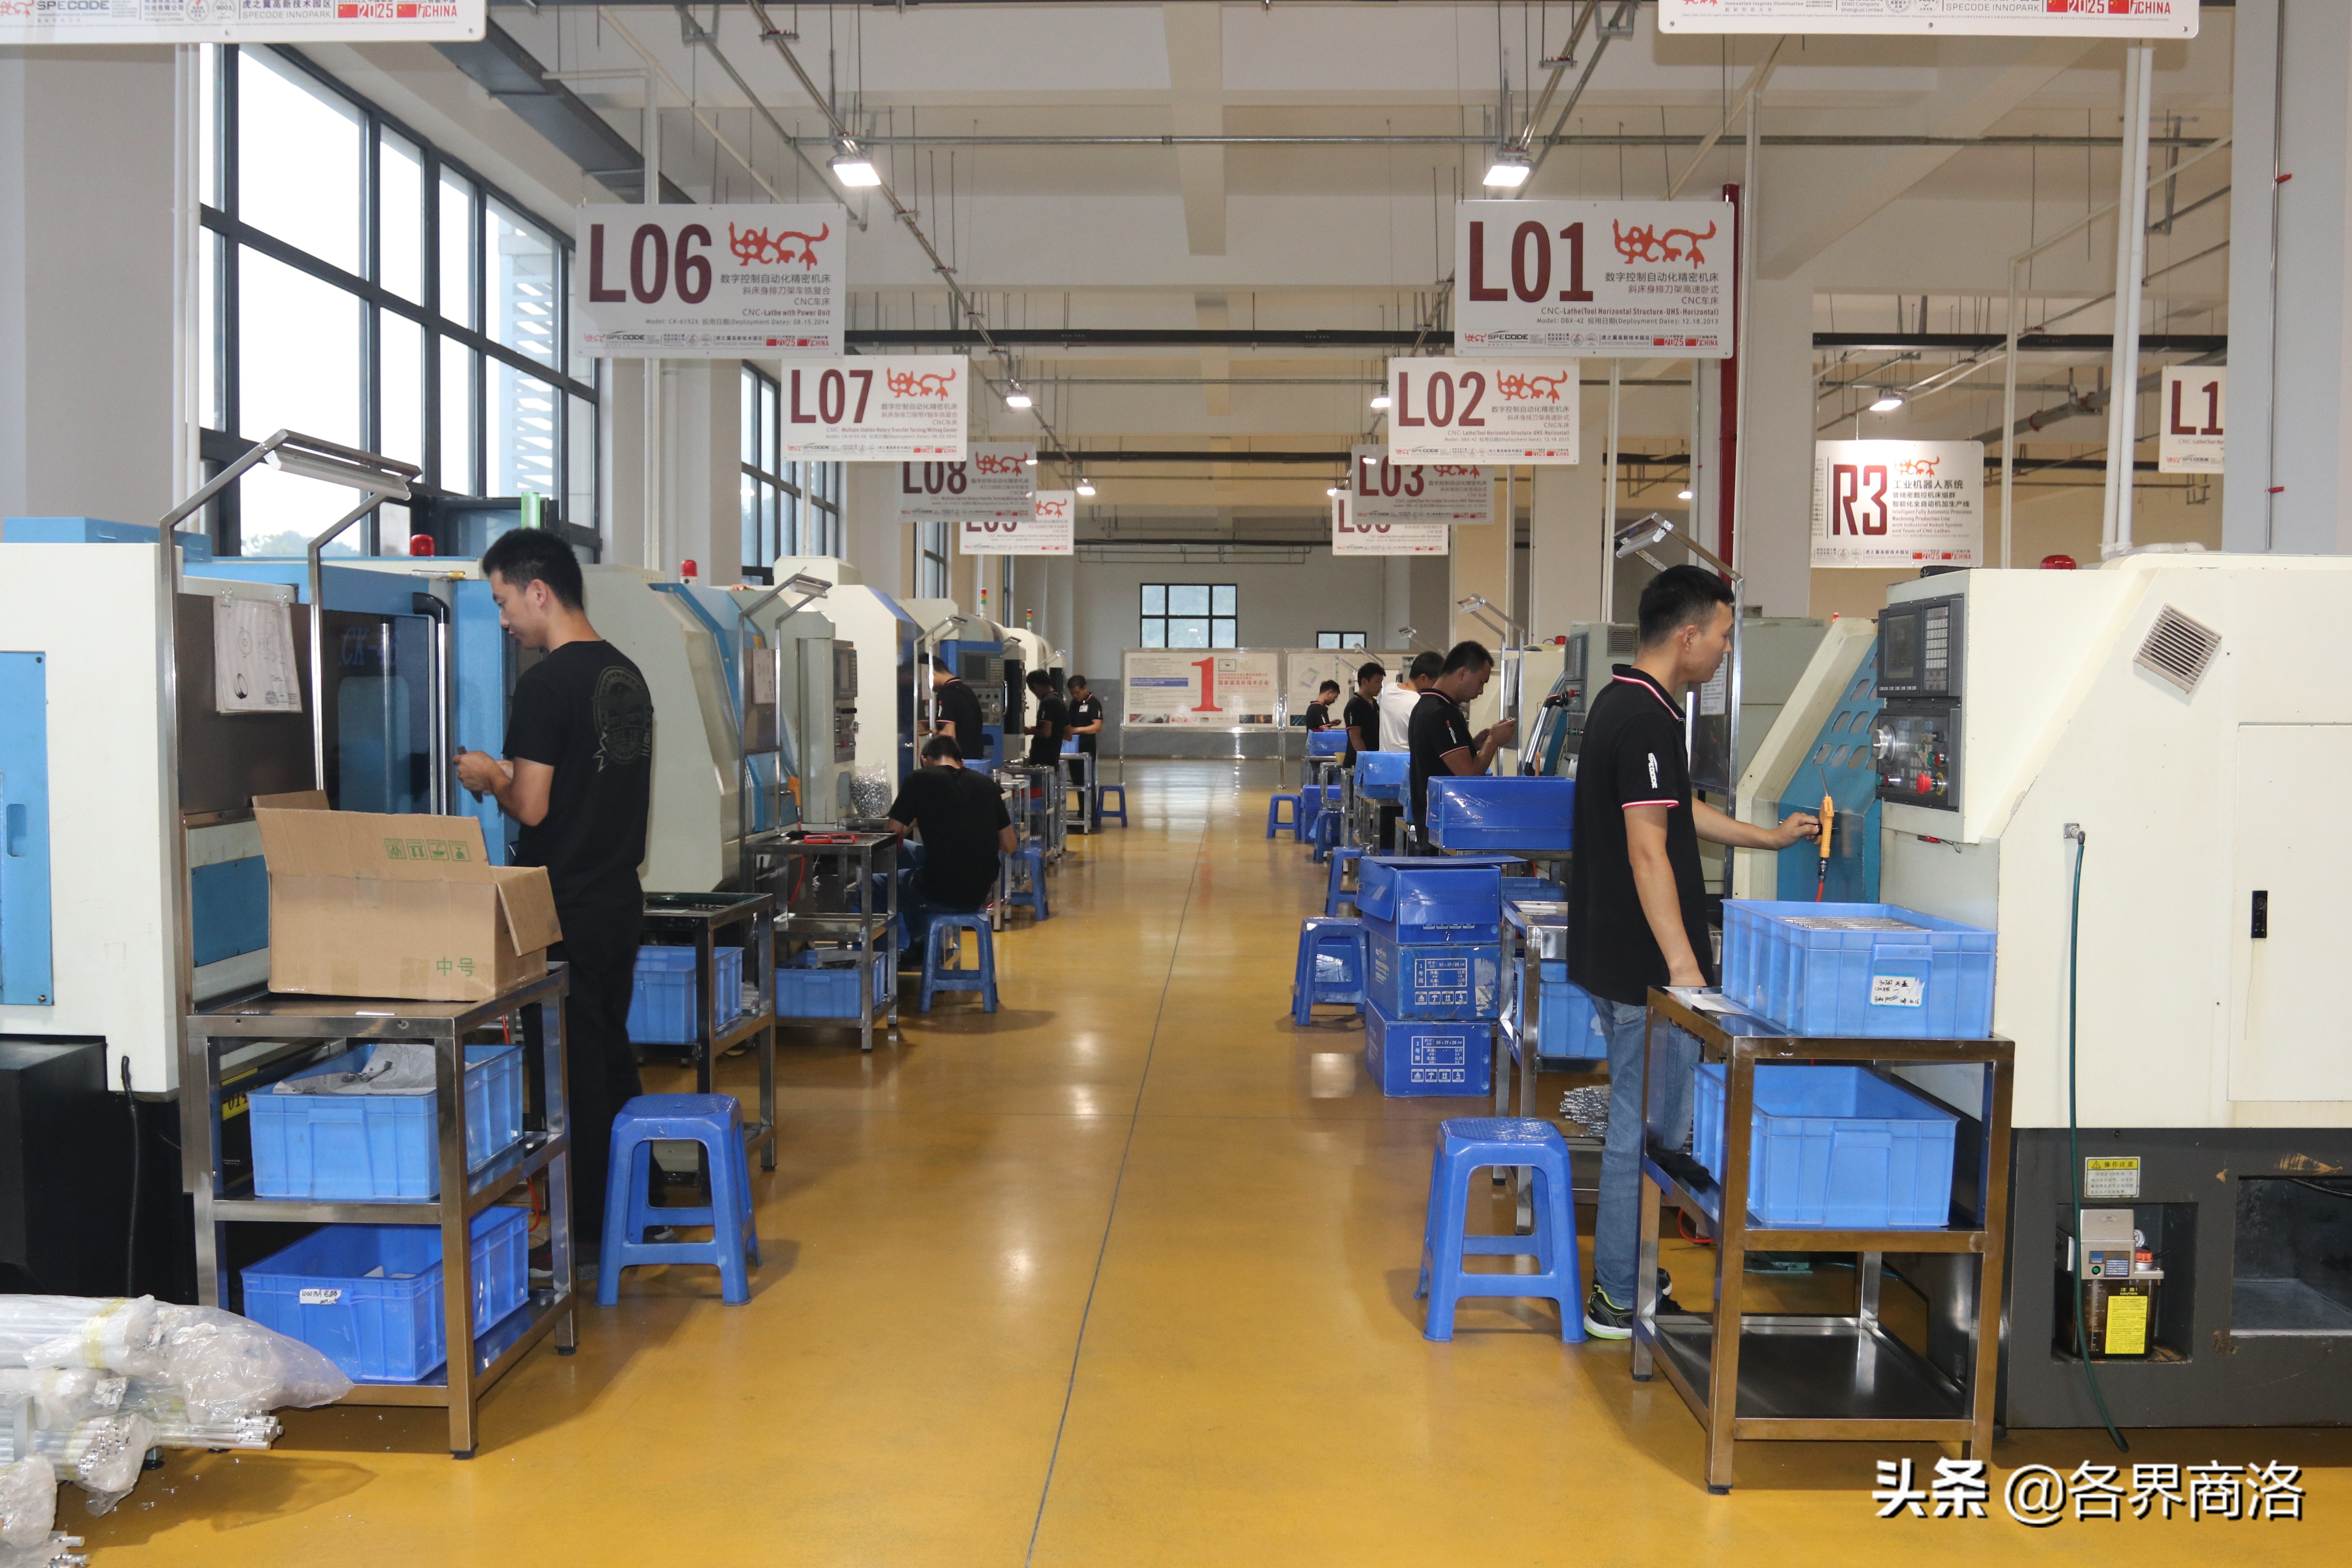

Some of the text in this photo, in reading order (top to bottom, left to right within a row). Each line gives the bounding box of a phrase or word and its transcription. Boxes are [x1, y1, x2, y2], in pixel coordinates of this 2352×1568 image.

[37, 0, 109, 10] SPECODE
[426, 5, 457, 17] CHINA
[2138, 1, 2171, 14] CHINA
[589, 223, 712, 304] L06
[1469, 220, 1593, 303] L01
[720, 274, 831, 283] 数字控制自动化精密机床
[1605, 272, 1719, 282] 数字控制自动化精密机床
[1628, 285, 1719, 294] 斜床身排刀架高速卧式
[742, 287, 830, 295] 斜床身排刀架车铣复合
[791, 369, 873, 424] L07
[1398, 371, 1485, 427] L02
[903, 461, 966, 494] L08
[1359, 455, 1424, 496] L03
[1893, 479, 1964, 489] 工业机器人系统
[1833, 464, 1887, 535] R3
[1192, 657, 1223, 711] 1
[1648, 753, 1658, 789] SPECODE
[436, 957, 475, 977] 中号
